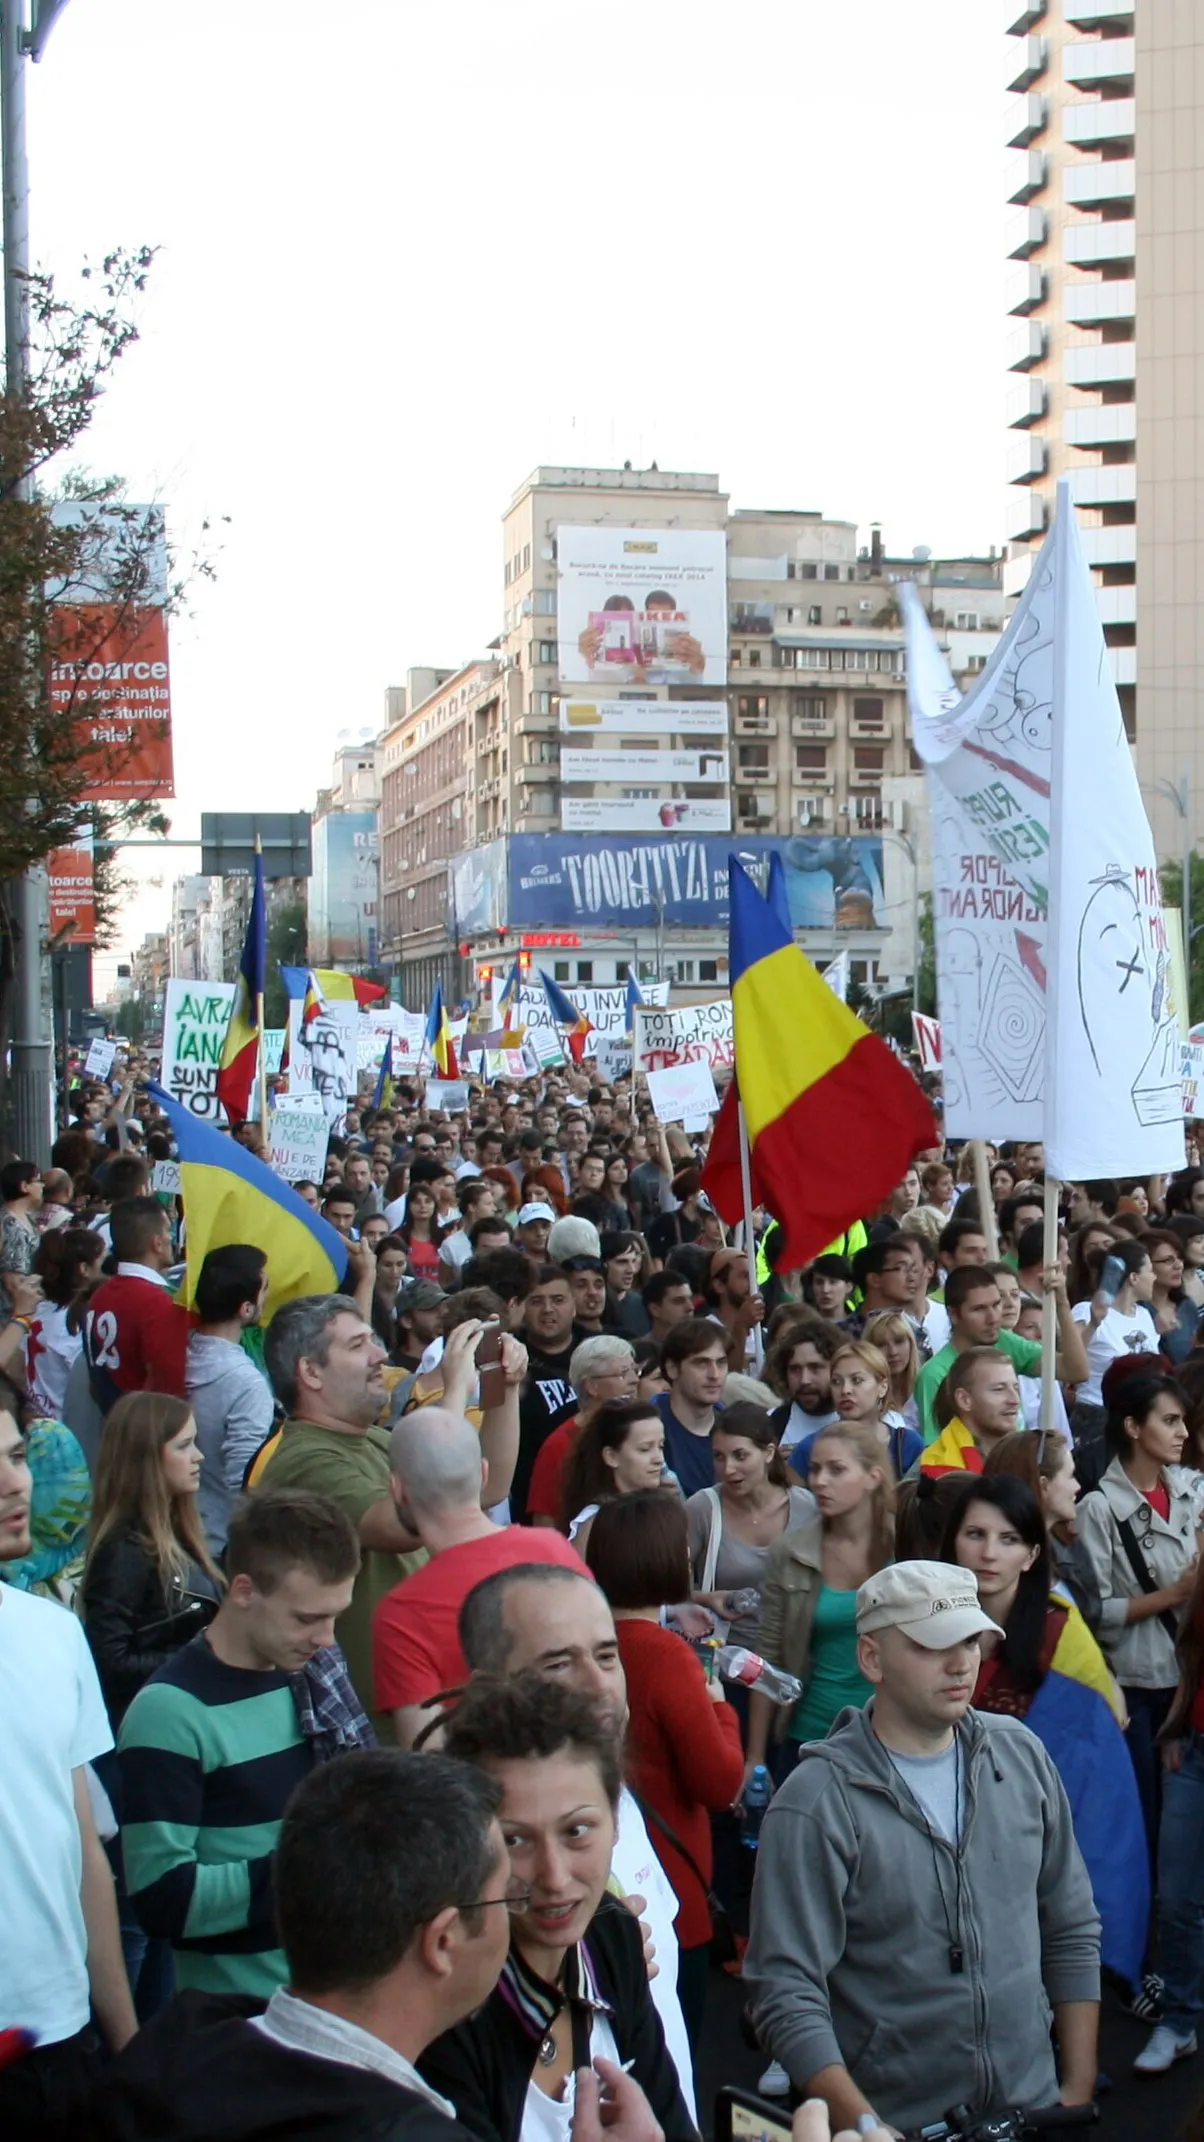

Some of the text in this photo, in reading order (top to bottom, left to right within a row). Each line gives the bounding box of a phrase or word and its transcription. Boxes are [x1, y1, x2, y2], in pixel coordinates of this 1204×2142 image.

[638, 610, 687, 621] IKEA
[51, 689, 88, 703] spe
[353, 831, 379, 847] RE
[49, 876, 93, 887] toarce
[176, 994, 230, 1024] AVRA
[915, 1016, 942, 1065] N
[170, 1066, 219, 1094] SUNT
[271, 1147, 318, 1166] NU E DE
[86, 1310, 120, 1369] 12
